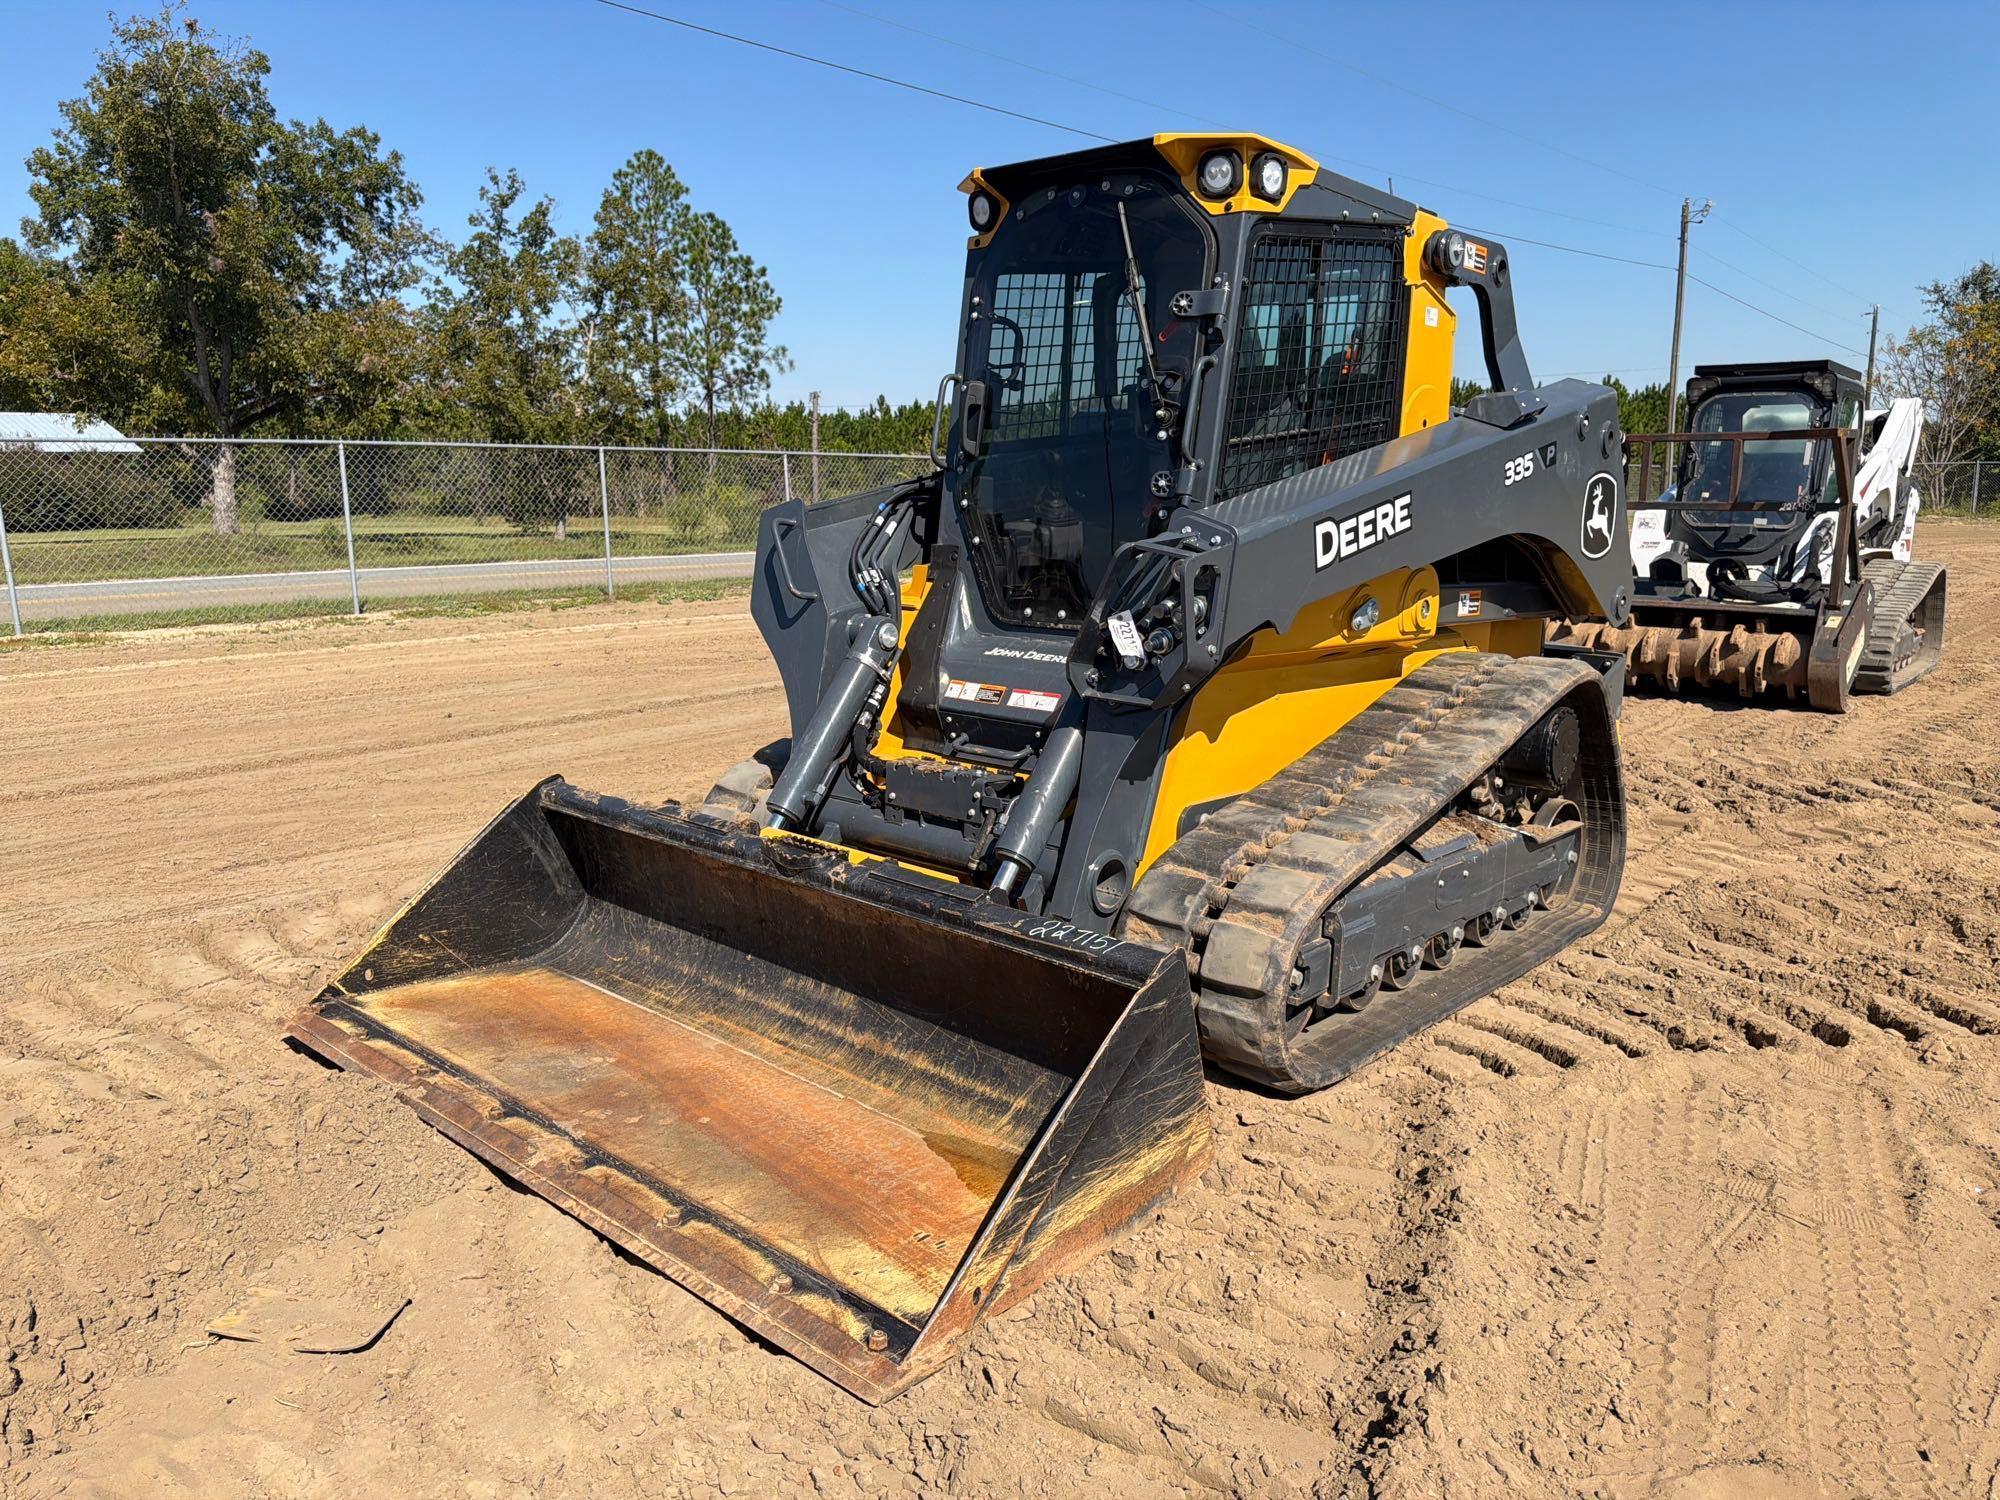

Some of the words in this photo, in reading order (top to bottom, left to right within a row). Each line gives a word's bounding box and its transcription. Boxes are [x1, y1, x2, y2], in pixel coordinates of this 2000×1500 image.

[1504, 452, 1534, 486] 335
[1546, 445, 1555, 466] P
[1315, 494, 1411, 569] DEERE
[984, 647, 1025, 658] JOHN
[1028, 920, 1127, 954] 227151
